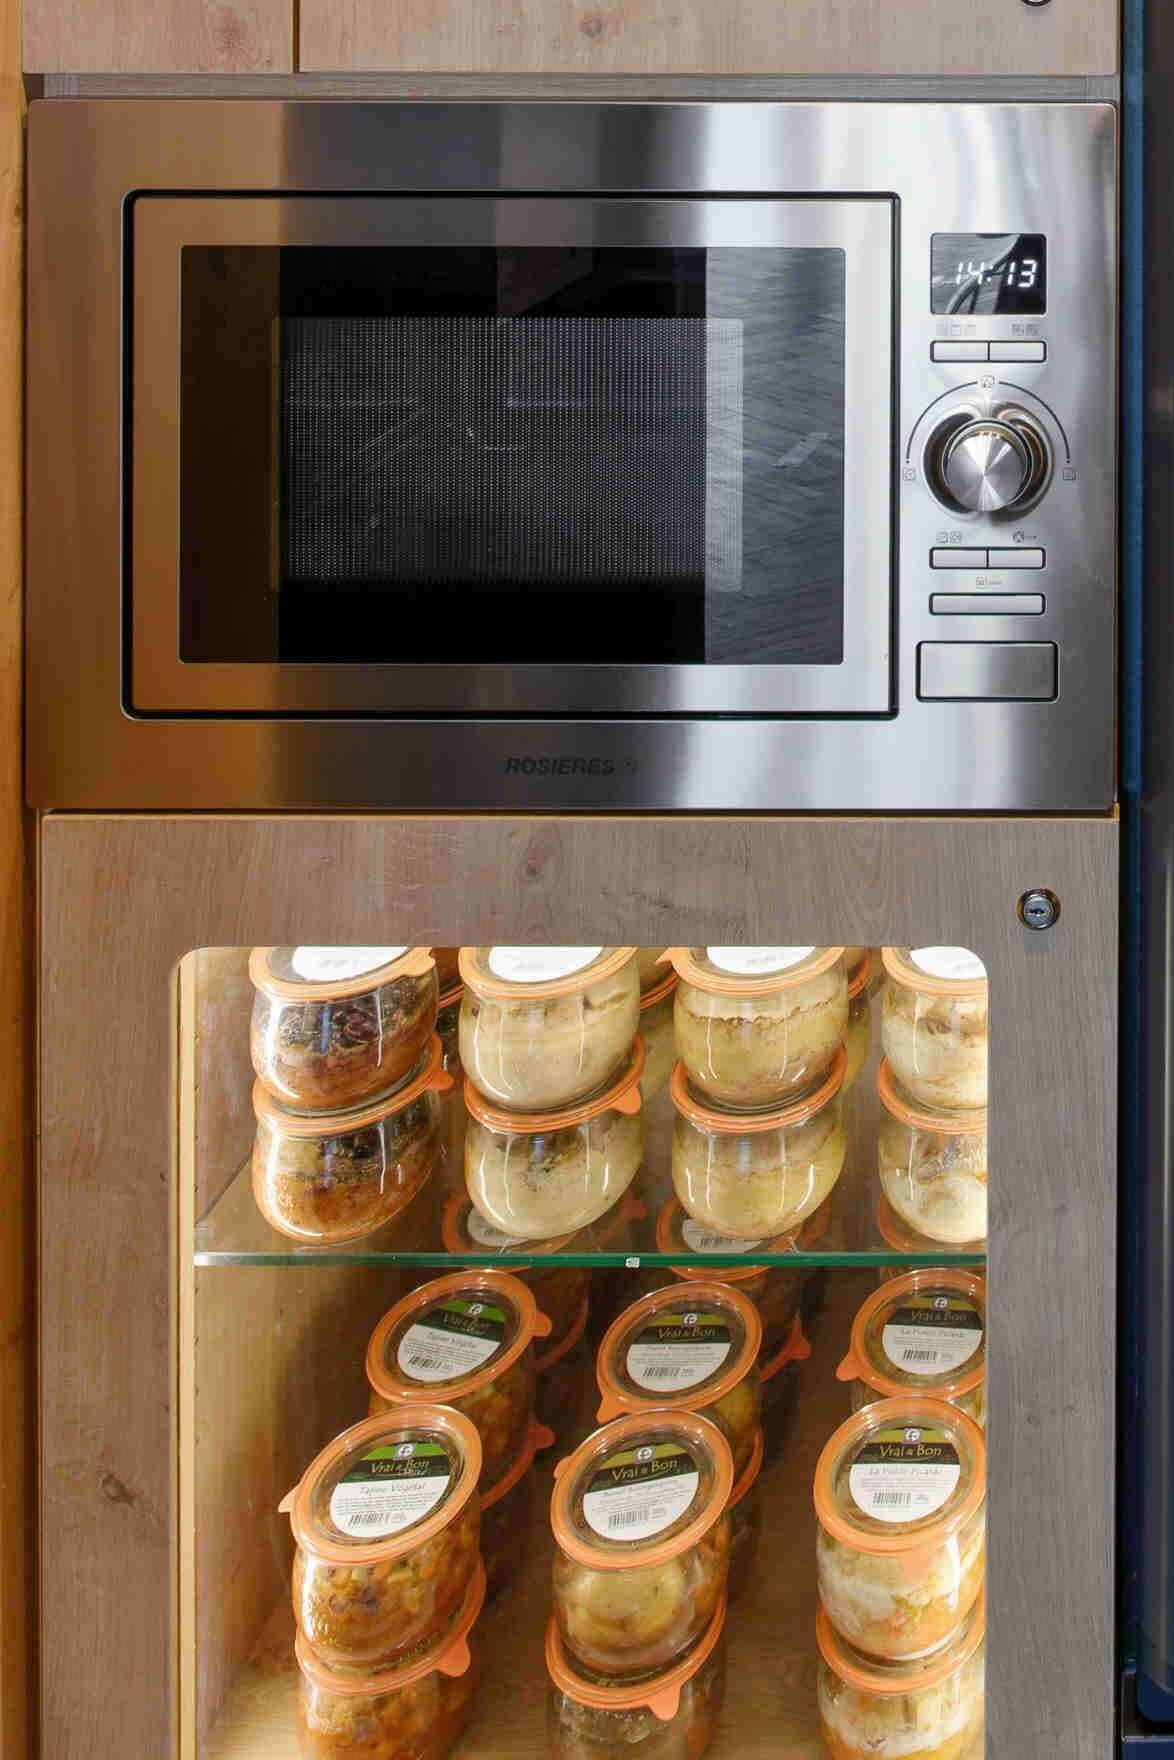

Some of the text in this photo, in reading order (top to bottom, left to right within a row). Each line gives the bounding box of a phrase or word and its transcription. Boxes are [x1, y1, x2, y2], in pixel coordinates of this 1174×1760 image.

[955, 258, 1038, 288] 14:13
[879, 1444, 905, 1457] Vrai
[916, 1444, 943, 1457] Bon
[611, 1466, 640, 1481] Vrai
[651, 1459, 680, 1473] Bon
